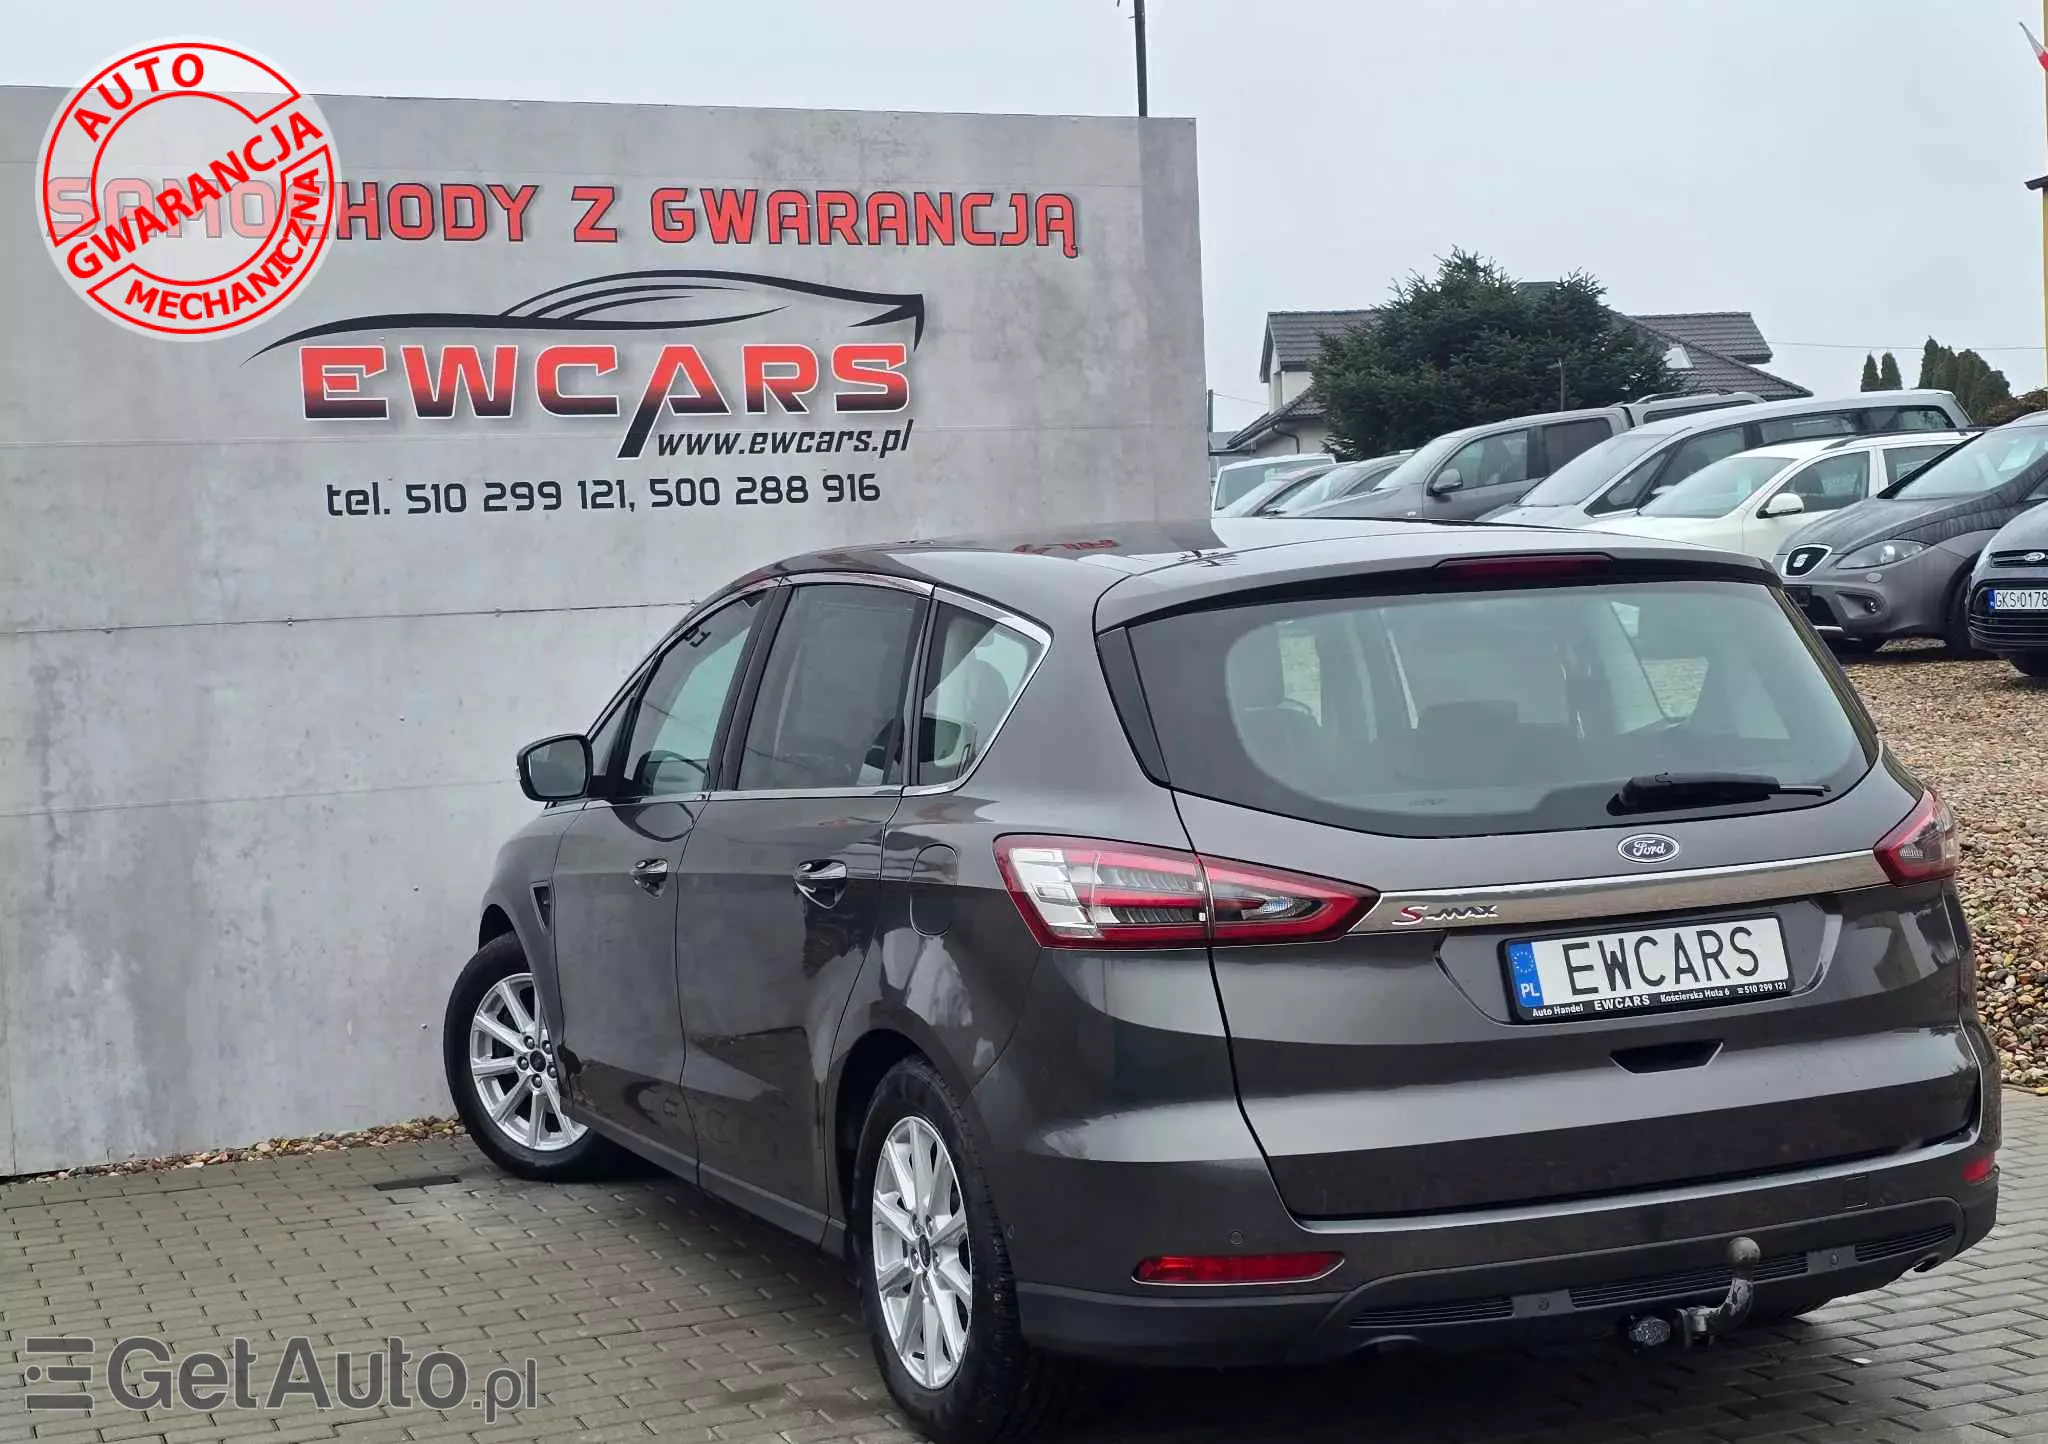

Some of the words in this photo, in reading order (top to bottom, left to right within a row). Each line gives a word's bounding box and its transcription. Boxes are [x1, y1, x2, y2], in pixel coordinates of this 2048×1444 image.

[572, 186, 618, 244] Z
[650, 187, 1081, 259] GWARANCJĄ
[300, 344, 911, 460] EWCARS
[658, 419, 914, 459] www.ewcars.pl
[326, 481, 390, 516] tel.
[405, 482, 467, 514] 510
[483, 480, 562, 513] 299
[577, 479, 635, 513] 121,
[649, 476, 721, 508] 500
[735, 475, 809, 505] 288
[822, 473, 881, 503] 916
[1995, 591, 2016, 608] GKS
[1561, 926, 1760, 997] EWCARS
[1520, 981, 1541, 999] PL
[1532, 1007, 1553, 1018] Auto
[1553, 1003, 1584, 1016] Handel
[1593, 994, 1651, 1012] EWCARS
[1744, 984, 1758, 995] 510
[1774, 981, 1788, 992] 121
